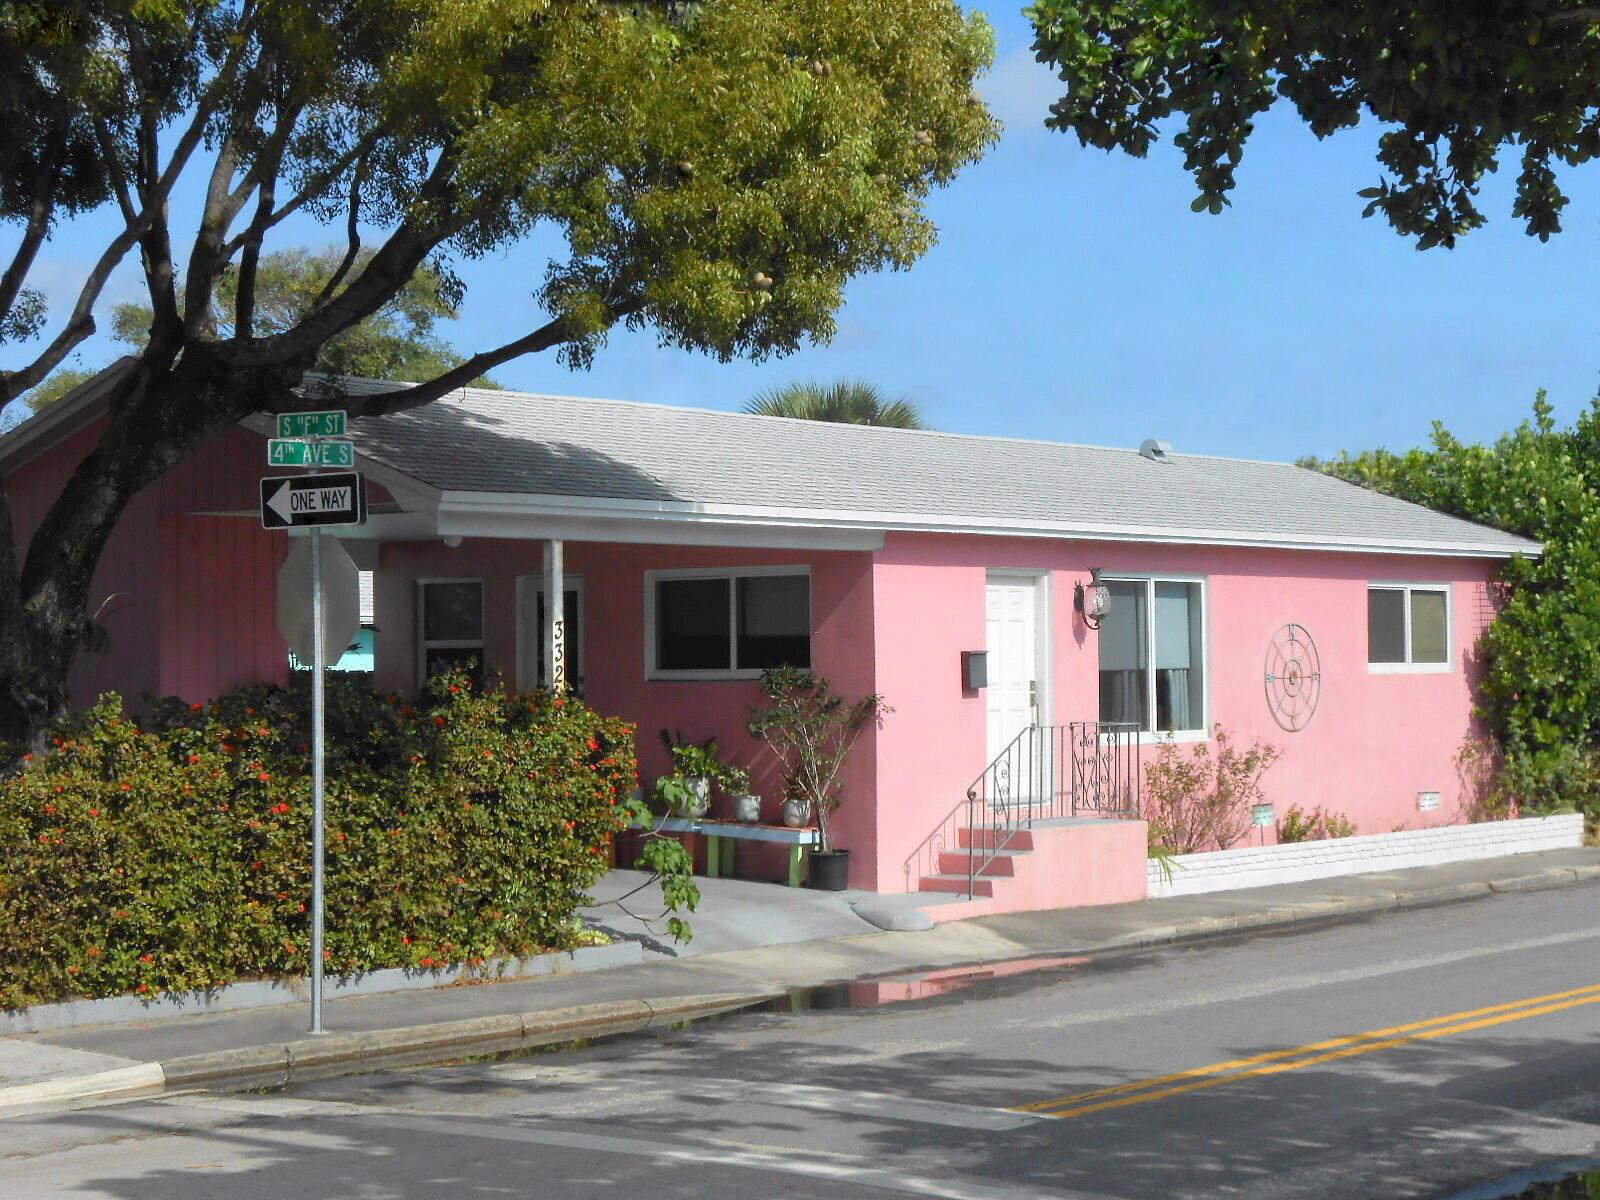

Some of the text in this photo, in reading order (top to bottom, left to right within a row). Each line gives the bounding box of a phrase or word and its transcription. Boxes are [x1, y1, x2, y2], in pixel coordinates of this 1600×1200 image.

[283, 416, 291, 435] S
[325, 414, 340, 433] ST
[274, 443, 348, 464] 4TH AVE S
[290, 489, 347, 511] ONE WAY
